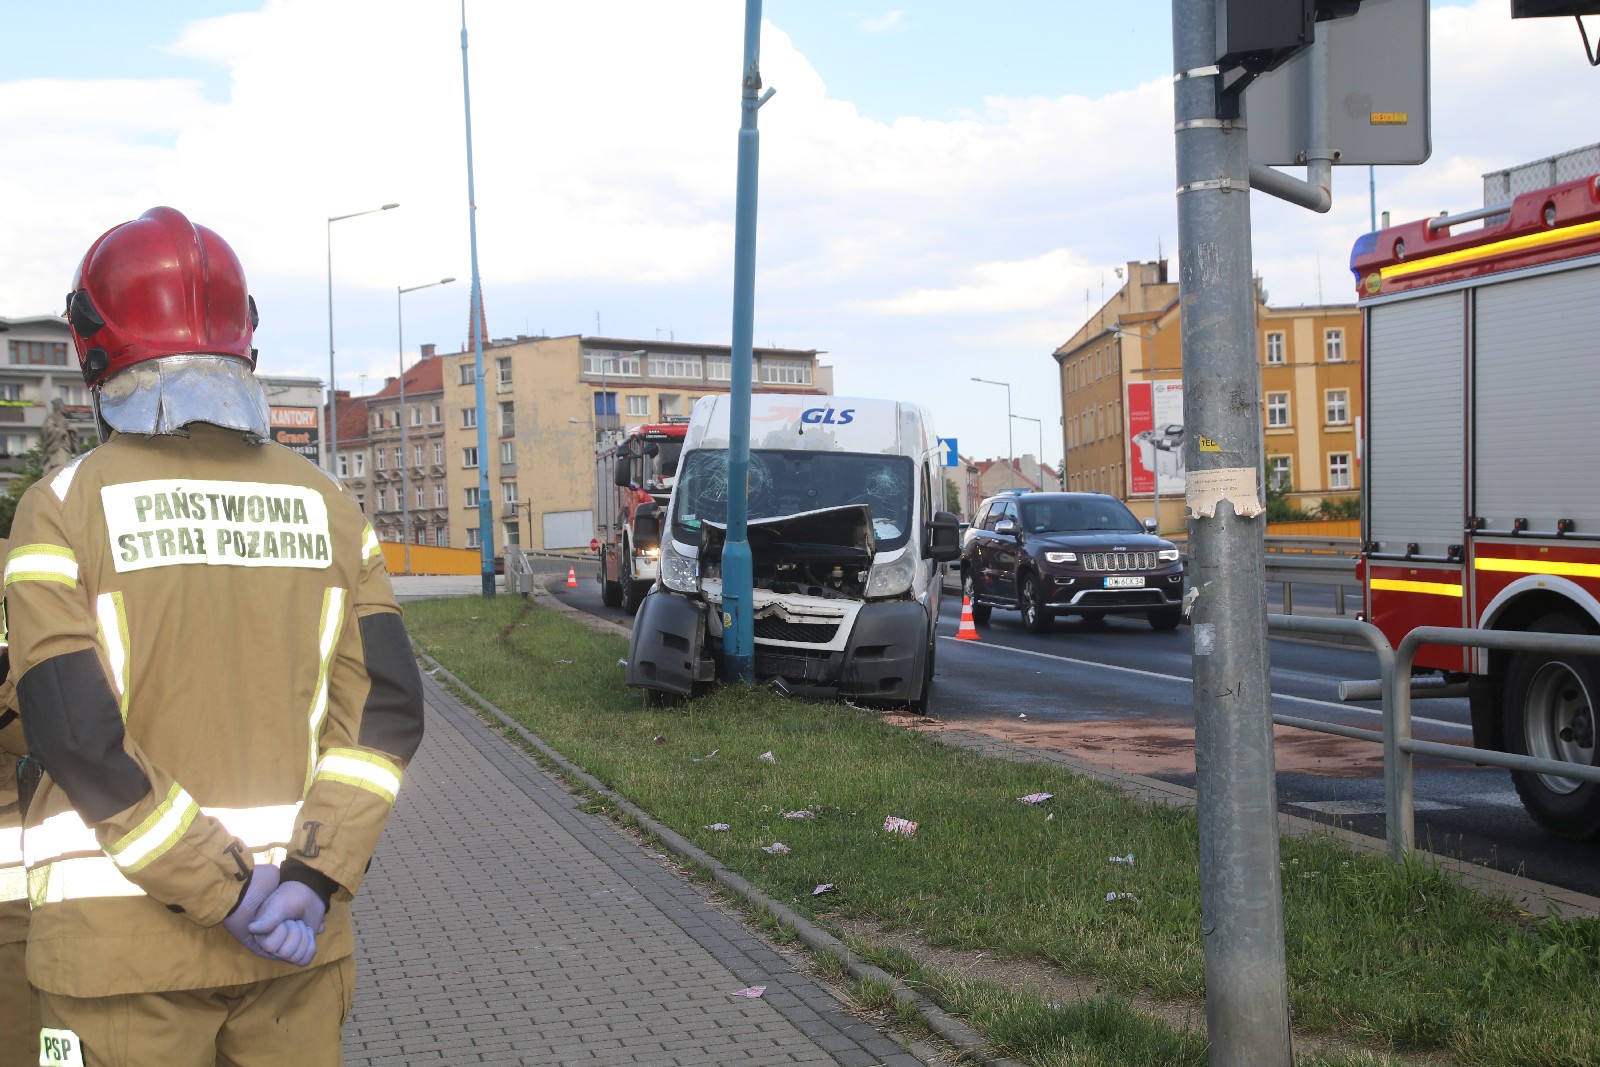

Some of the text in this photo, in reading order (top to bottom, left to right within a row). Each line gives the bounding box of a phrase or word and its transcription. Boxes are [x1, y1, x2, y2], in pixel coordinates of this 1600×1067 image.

[270, 409, 315, 425] KANTORY
[801, 408, 855, 424] GLS
[276, 430, 310, 444] Grant
[134, 487, 309, 524] PAŃSTWOWA
[117, 527, 329, 562] STRAŻ POŻARNA
[44, 1036, 71, 1060] PSP
